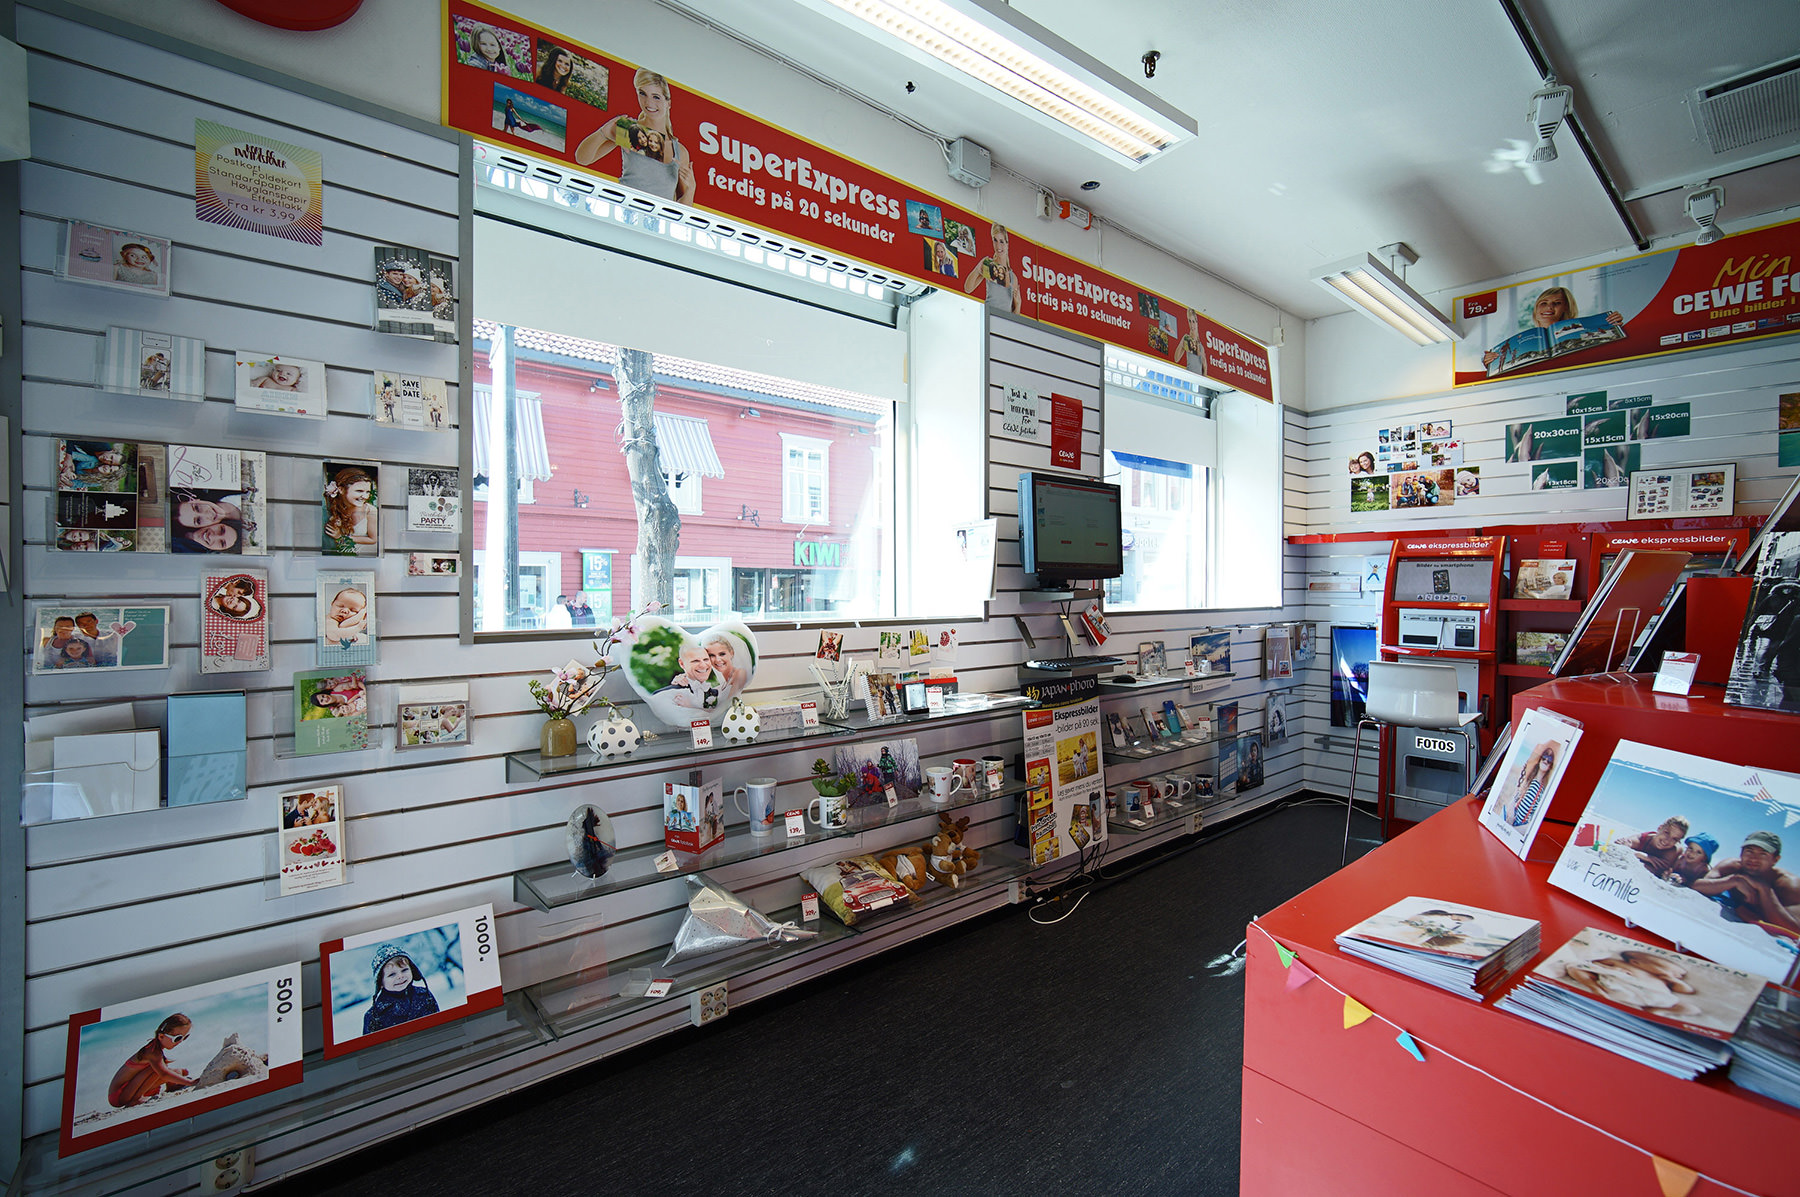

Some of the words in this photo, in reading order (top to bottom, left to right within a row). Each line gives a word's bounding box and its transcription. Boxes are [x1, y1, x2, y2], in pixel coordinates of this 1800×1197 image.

[217, 154, 261, 172] Postkort
[698, 121, 901, 220] SuperExpress
[209, 166, 289, 192] Standardpapir
[252, 169, 302, 189] Foldekort
[231, 180, 307, 205] Høyglanspapir
[227, 198, 249, 211] Fra
[253, 204, 265, 214] kr
[251, 194, 303, 212] Effektlakk
[708, 167, 766, 206] ferdig
[771, 190, 794, 212] på
[799, 198, 820, 220] 20
[824, 210, 895, 244] sekunder
[1712, 254, 1791, 288] Min
[1022, 256, 1134, 312] SuperExpress
[1673, 280, 1764, 315] CEWE
[1026, 287, 1059, 311] ferdig
[1061, 298, 1074, 313] på
[1076, 302, 1088, 317] 20
[1090, 308, 1132, 330] sekunder
[1710, 307, 1740, 319] Dine
[1744, 299, 1787, 313] bilder
[1206, 331, 1267, 371] SuperExpress
[401, 380, 420, 388] SAVE
[402, 390, 420, 398] DATE
[1572, 406, 1603, 414] 10x15cm
[1650, 412, 1690, 421] 15x20cm
[1534, 428, 1579, 439] 20x30cm
[1585, 435, 1625, 444] 15x15cm
[1428, 541, 1490, 550] ekspressbilder
[1641, 535, 1726, 545] ekspressbilder
[794, 540, 840, 567] KIWI
[1055, 705, 1098, 720] Ekspressbilder
[1416, 738, 1454, 752] FOTOS
[1584, 862, 1640, 904] Familie
[1598, 932, 1749, 978] INSPIRASJON
